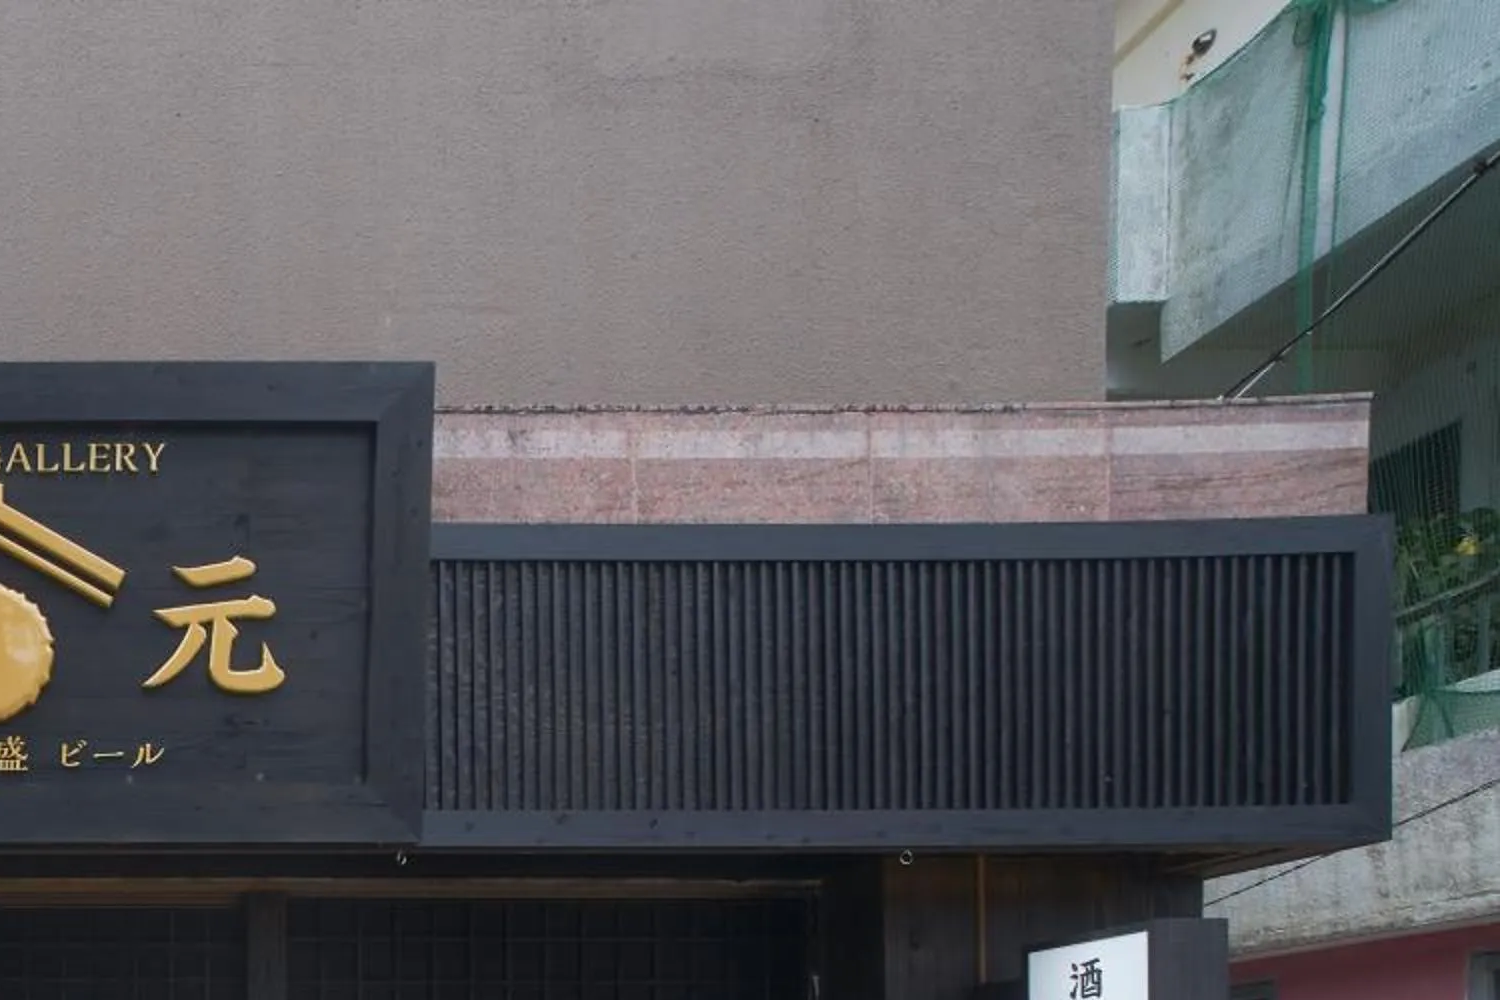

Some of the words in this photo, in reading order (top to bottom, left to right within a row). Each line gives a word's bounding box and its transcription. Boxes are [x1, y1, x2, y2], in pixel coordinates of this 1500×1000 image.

[59, 738, 166, 769] ビール
[1068, 957, 1104, 1000] 酒
